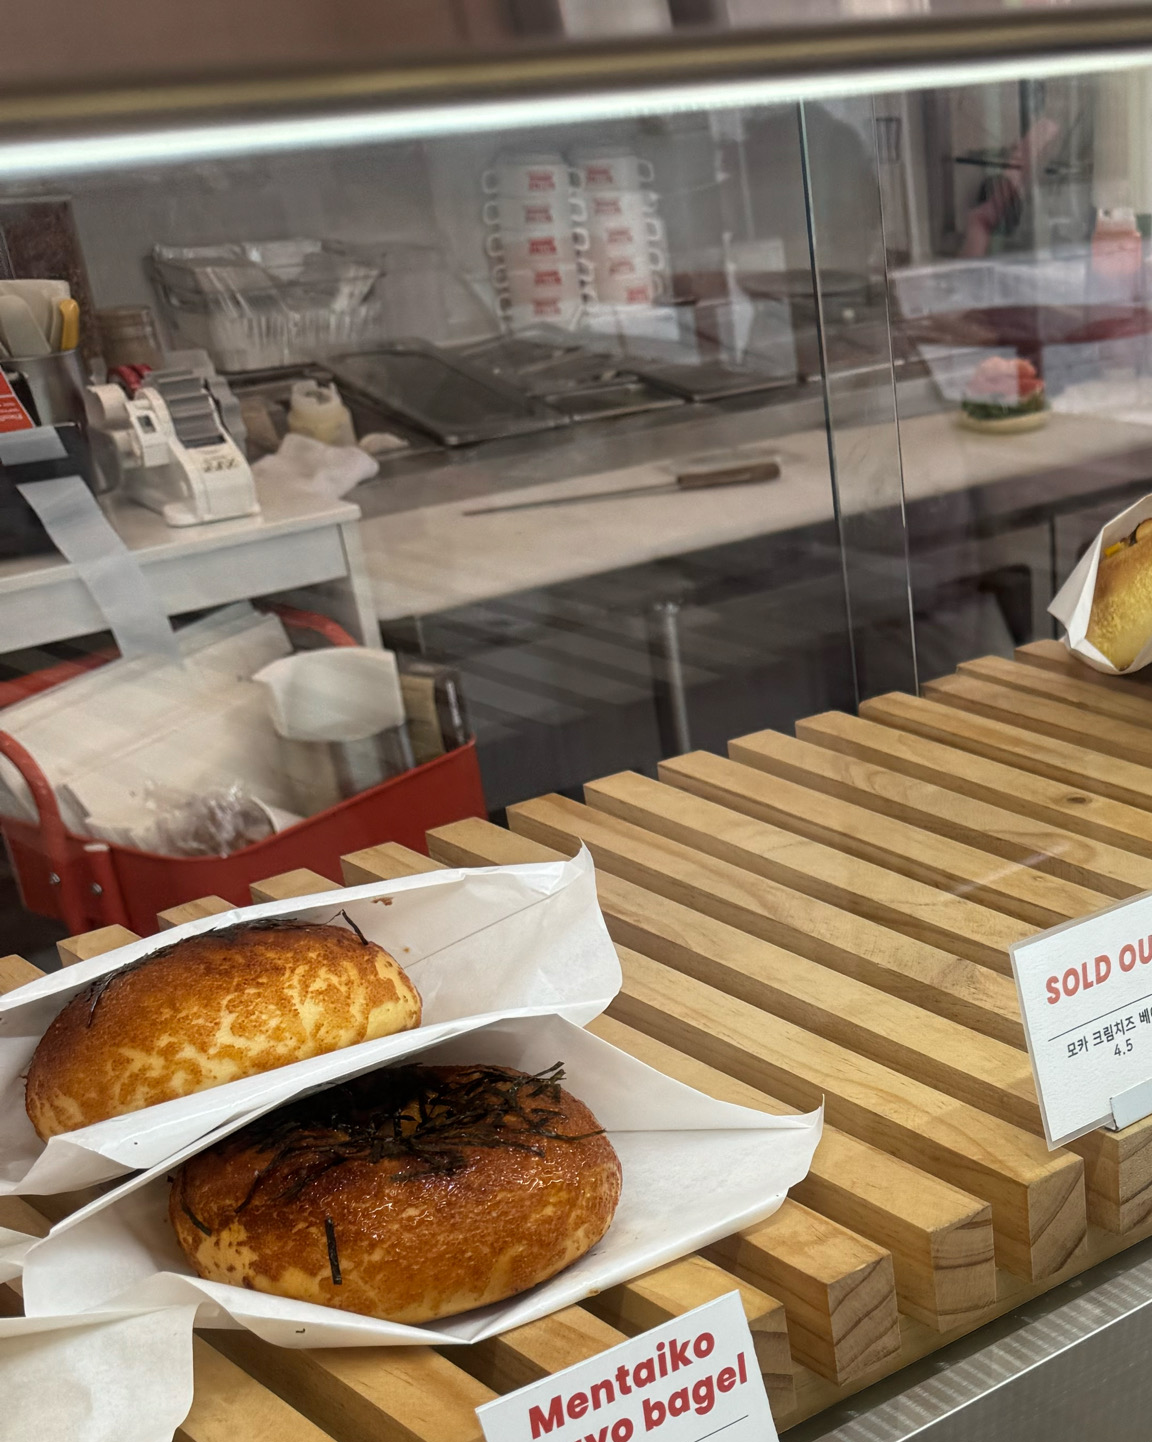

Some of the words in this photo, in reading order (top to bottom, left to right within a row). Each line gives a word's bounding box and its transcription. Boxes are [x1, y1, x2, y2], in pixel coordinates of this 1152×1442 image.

[1045, 954, 1112, 1005] SOLD
[1067, 1036, 1089, 1058] 모카
[1093, 1015, 1137, 1048] 크림치즈
[1114, 1038, 1134, 1057] 4.5
[529, 1332, 716, 1440] Mentaiko
[642, 1352, 748, 1431] bagel
